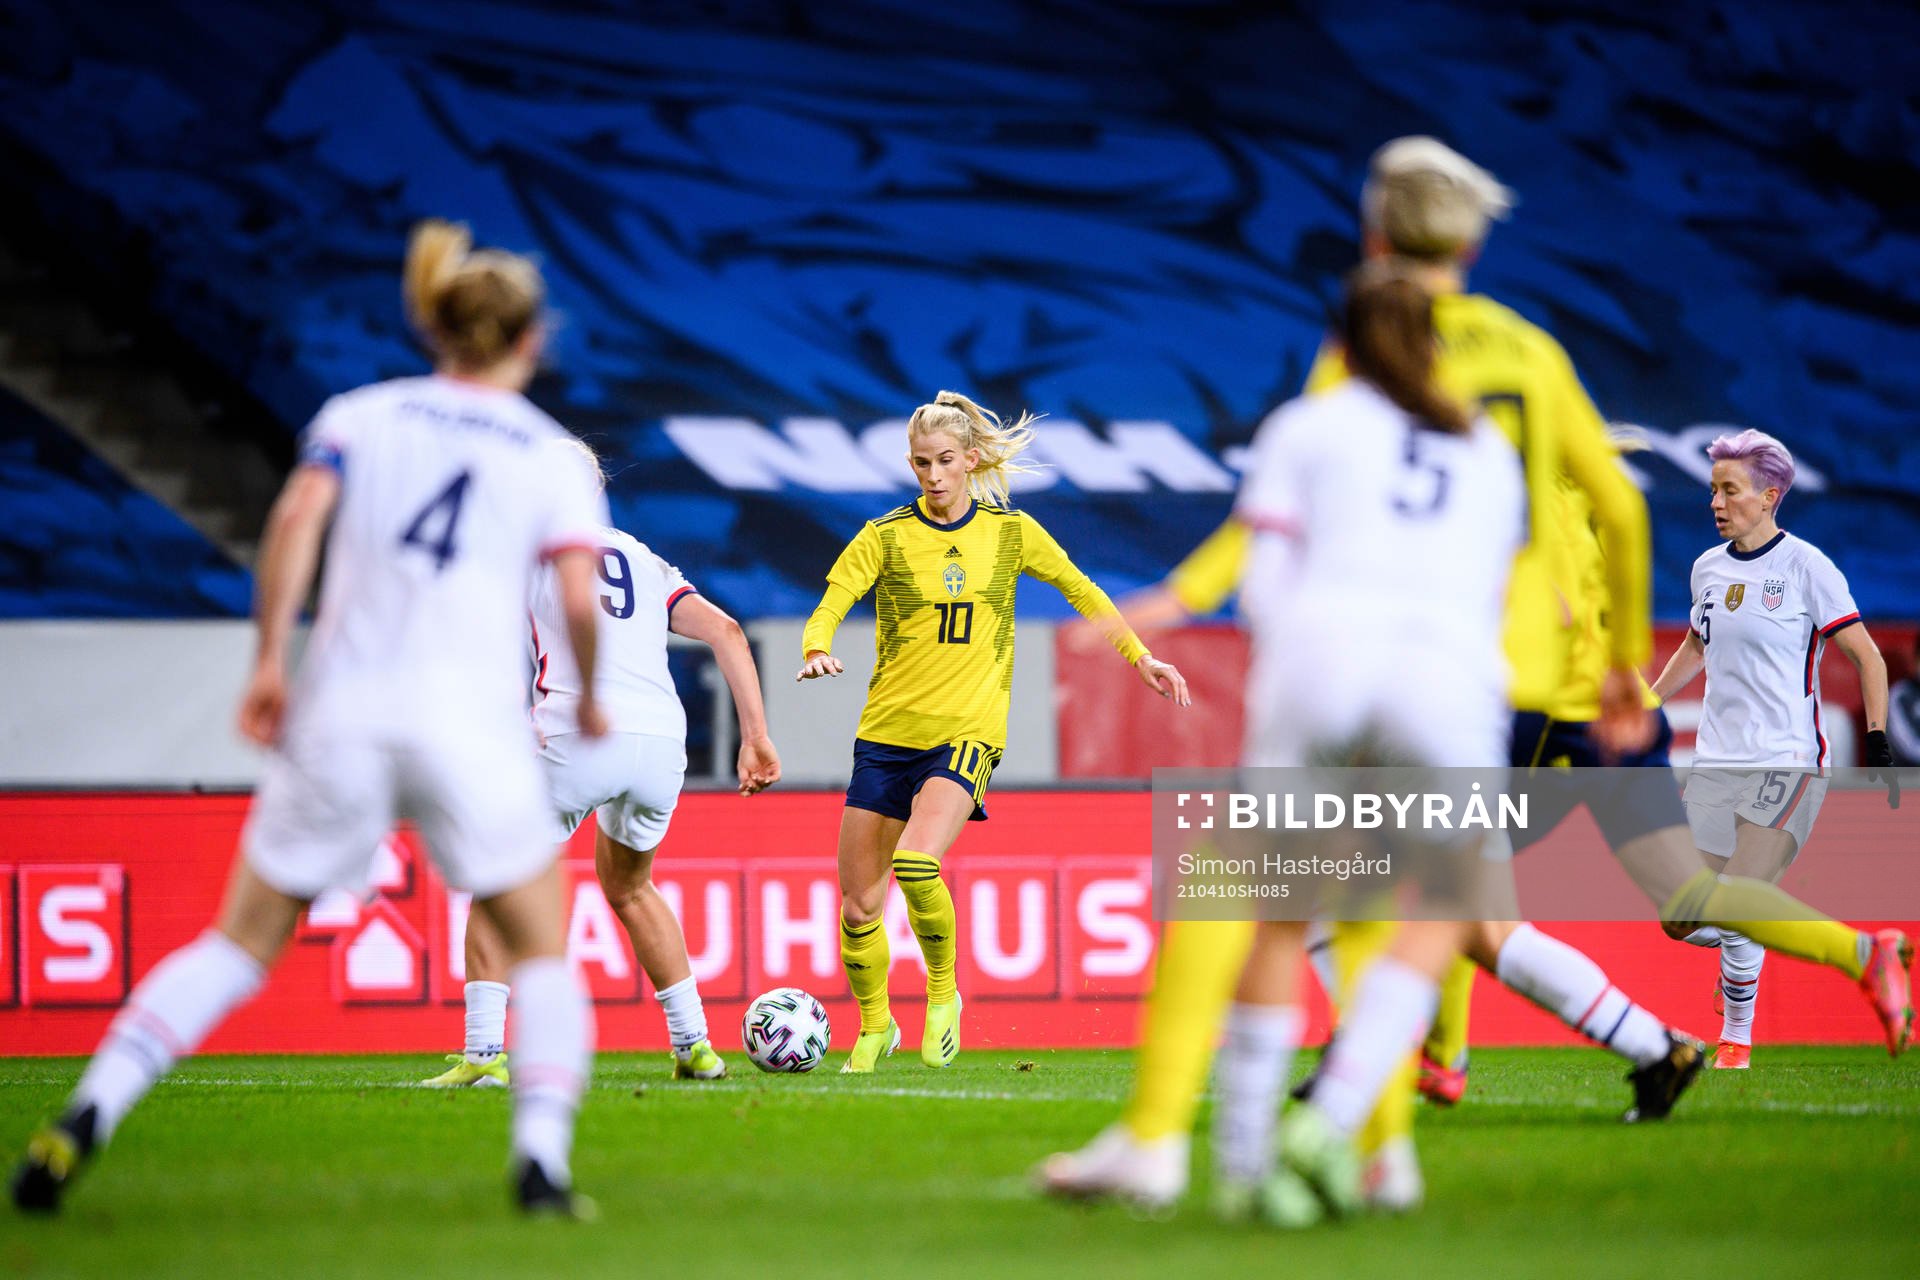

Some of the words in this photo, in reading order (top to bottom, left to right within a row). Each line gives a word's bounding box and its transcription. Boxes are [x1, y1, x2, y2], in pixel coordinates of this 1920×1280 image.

[402, 469, 470, 572] 4
[596, 547, 635, 619] 9
[1765, 585, 1783, 596] USA
[934, 602, 974, 644] 10
[947, 740, 987, 784] 10
[1757, 770, 1791, 806] 15
[446, 879, 1154, 980] AUHAUS
